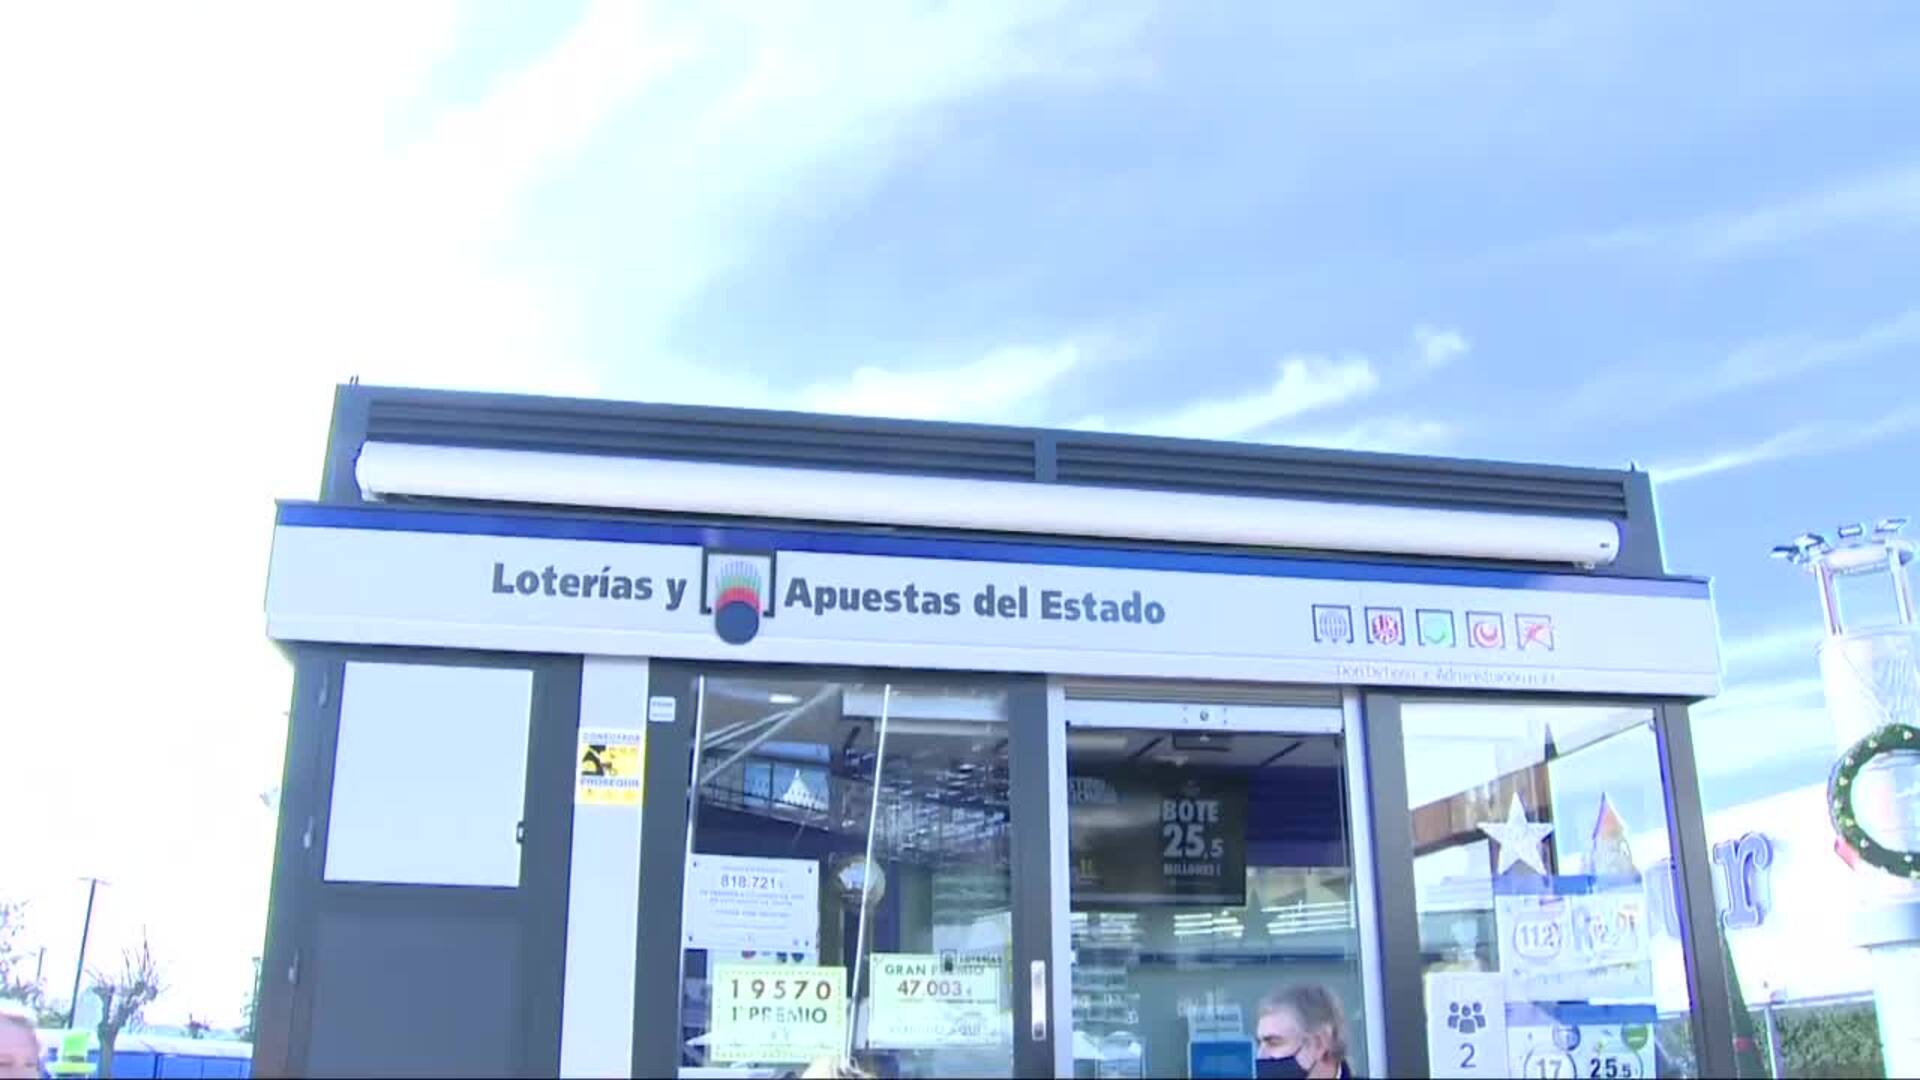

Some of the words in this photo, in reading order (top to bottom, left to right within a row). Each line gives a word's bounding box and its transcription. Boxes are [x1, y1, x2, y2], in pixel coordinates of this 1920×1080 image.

[492, 562, 653, 600] Loterías
[665, 577, 688, 612] y
[784, 577, 961, 616] Apuestas
[973, 584, 1029, 618] del
[1040, 589, 1166, 625] Estado
[1162, 799, 1220, 822] BOTE
[884, 963, 926, 976] GRAN
[731, 978, 832, 1001] 19570
[748, 1006, 828, 1024] PREMIO
[1459, 1043, 1476, 1068] 2
